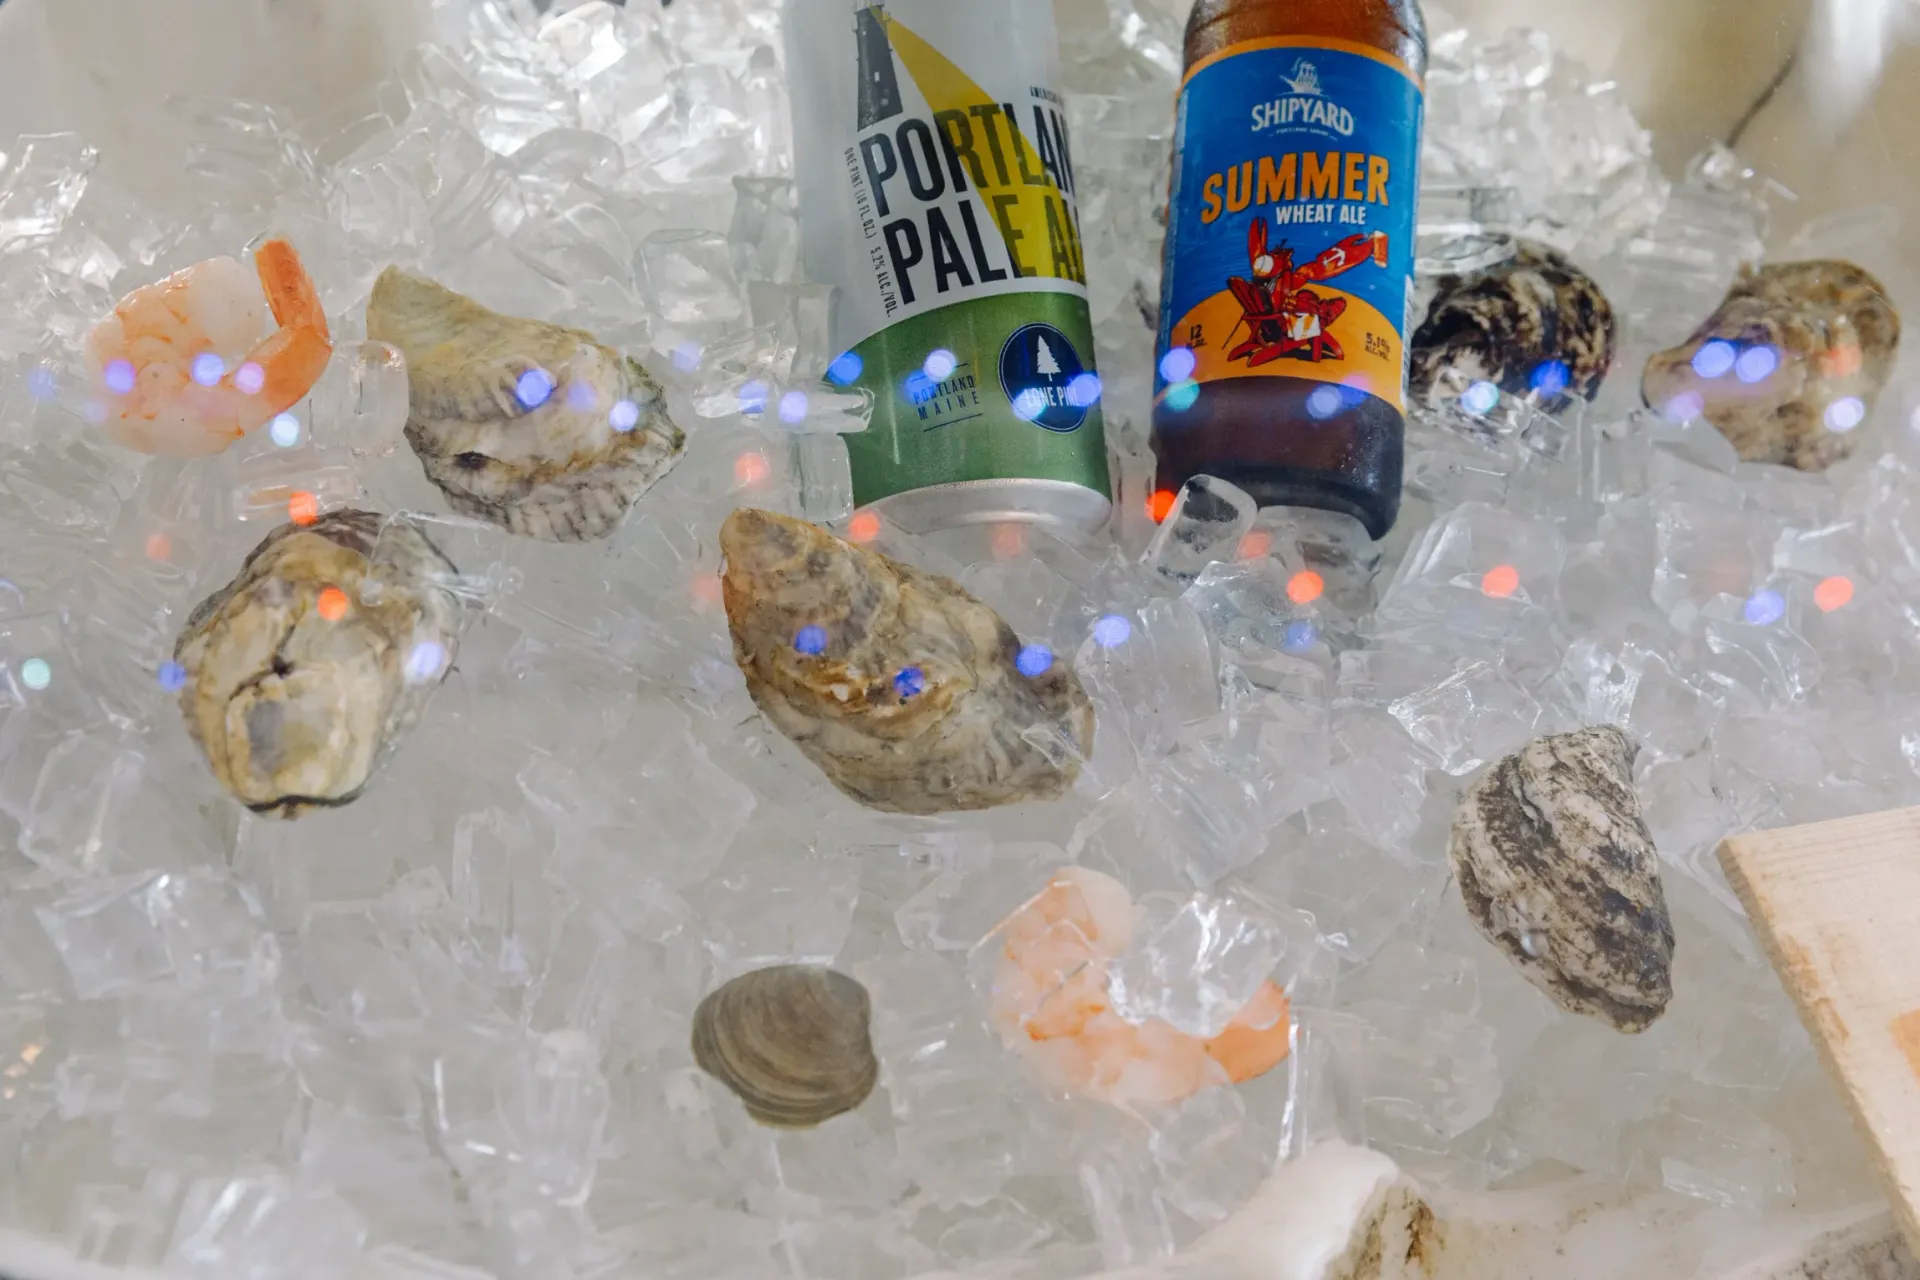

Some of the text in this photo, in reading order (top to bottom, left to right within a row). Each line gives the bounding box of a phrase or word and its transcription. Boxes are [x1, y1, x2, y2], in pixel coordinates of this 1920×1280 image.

[1251, 96, 1355, 136] SHIPYARD
[844, 146, 857, 166] ONE
[858, 102, 1077, 218] PORTLAN
[850, 166, 864, 189] PINT
[1201, 151, 1390, 225] SUMMER
[1275, 203, 1367, 226] WHEAT ALE
[870, 246, 886, 271] 5.2%
[882, 193, 1087, 306] PALE AL
[1190, 323, 1203, 341] 12
[913, 374, 976, 406] PORTLAND
[1023, 386, 1057, 408] LONE
[917, 390, 980, 421] MAINE
